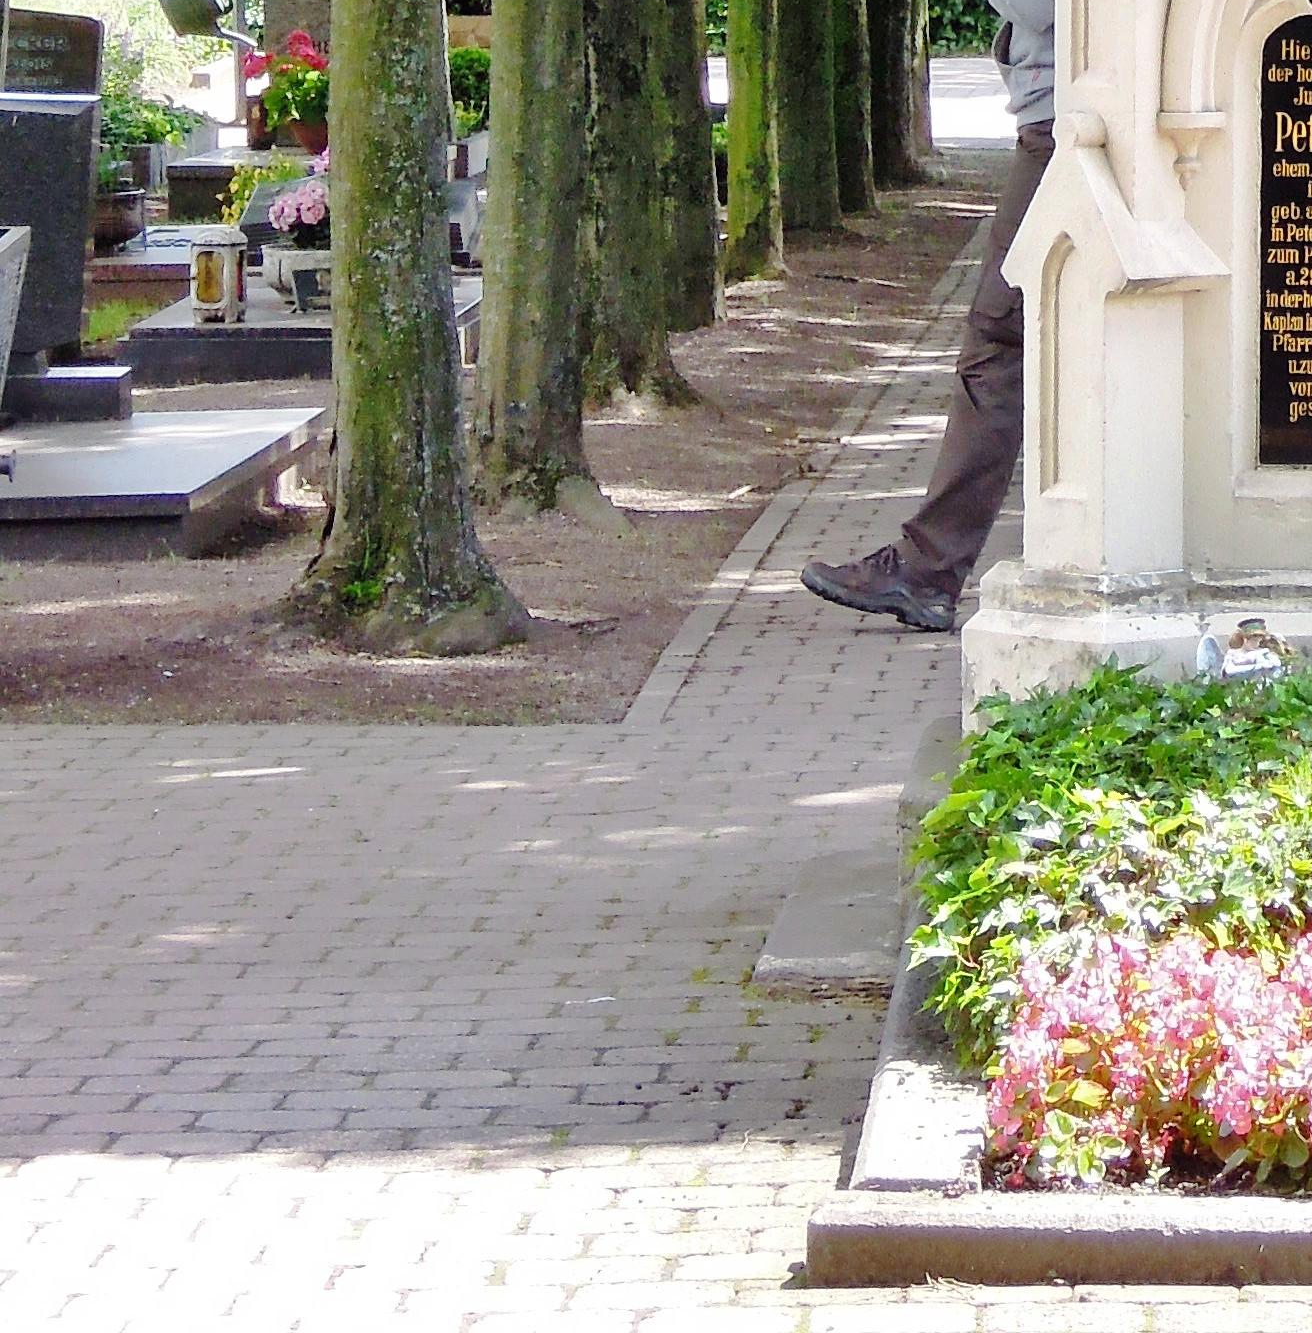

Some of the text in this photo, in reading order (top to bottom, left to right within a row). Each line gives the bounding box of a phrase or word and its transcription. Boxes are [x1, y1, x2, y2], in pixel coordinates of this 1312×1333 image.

[1267, 64, 1294, 83] der
[1270, 223, 1285, 243] in
[1266, 246, 1300, 264] zum
[1265, 290, 1279, 309] in
[1280, 290, 1302, 309] der
[1263, 313, 1304, 333] Kaplan
